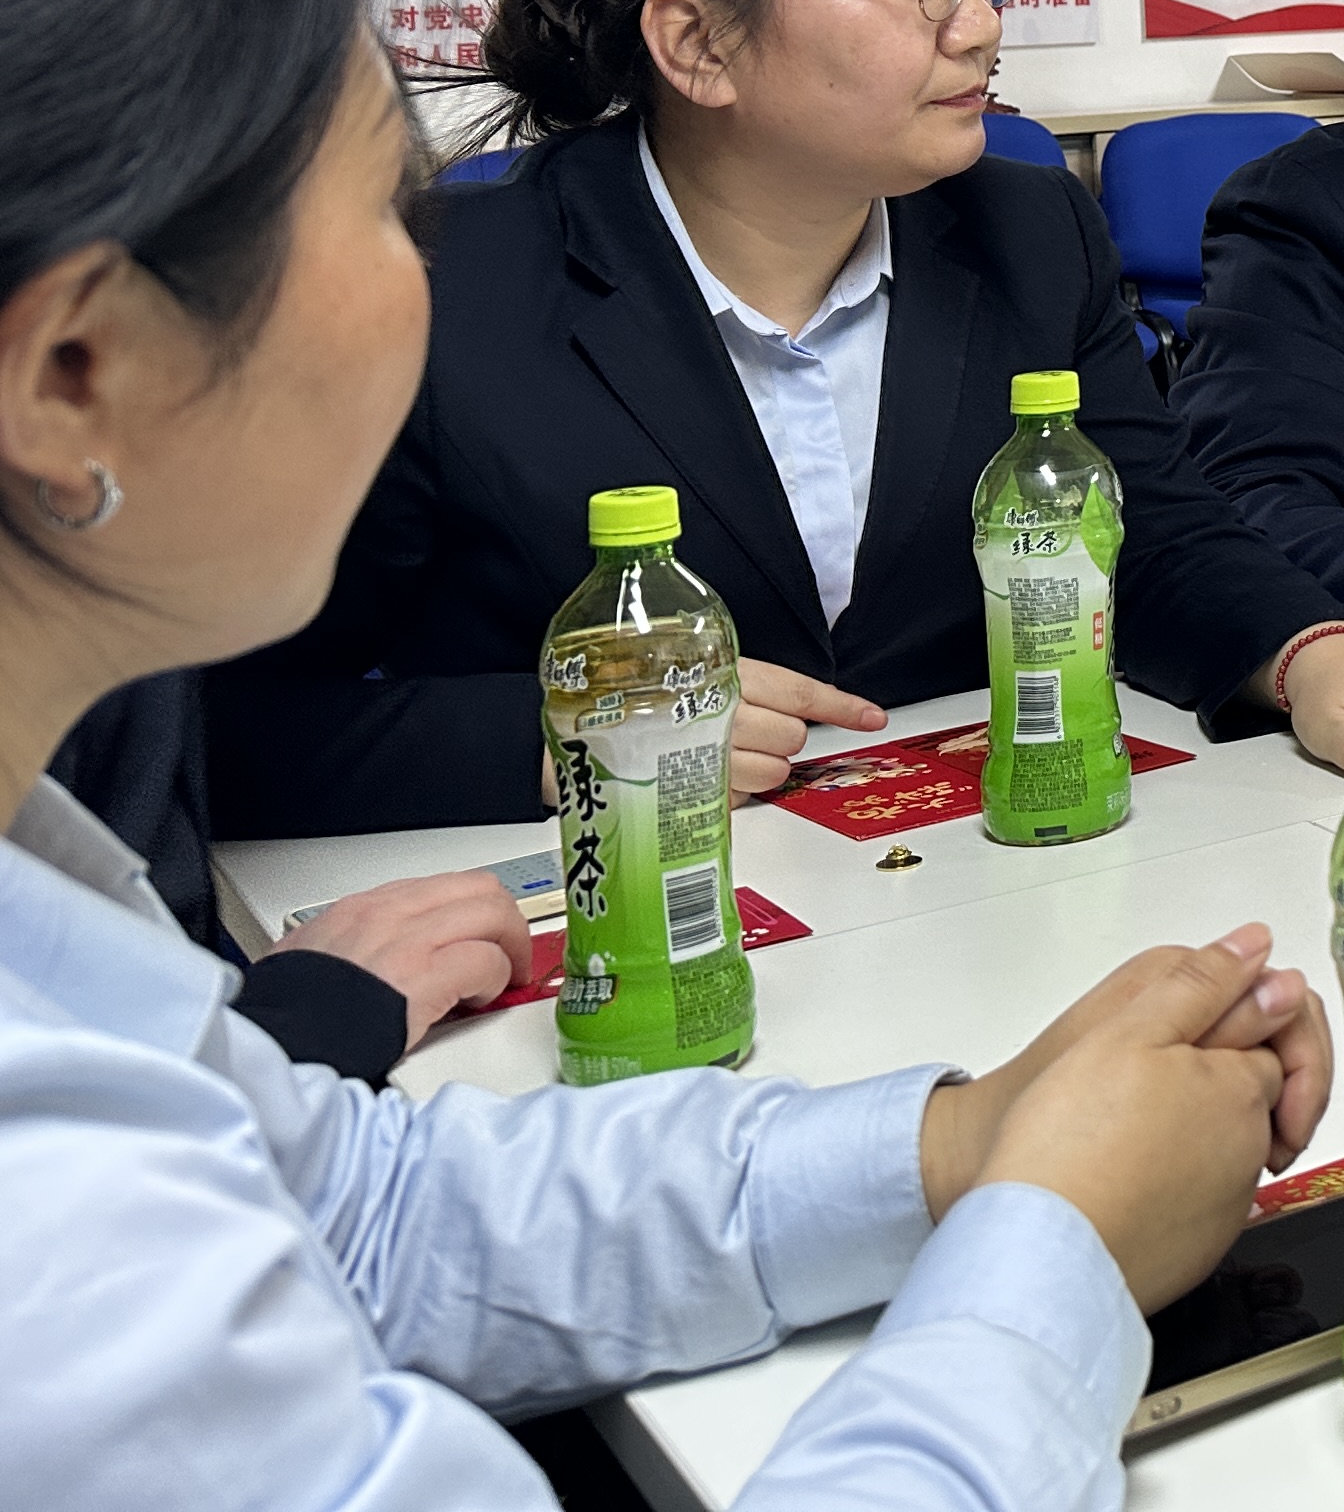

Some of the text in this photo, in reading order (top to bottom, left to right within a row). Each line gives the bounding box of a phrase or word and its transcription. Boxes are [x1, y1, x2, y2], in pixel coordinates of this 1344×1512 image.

[1011, 530, 1060, 557] 绿茶
[672, 682, 723, 726] 绿茶
[555, 737, 609, 922] 绿茶
